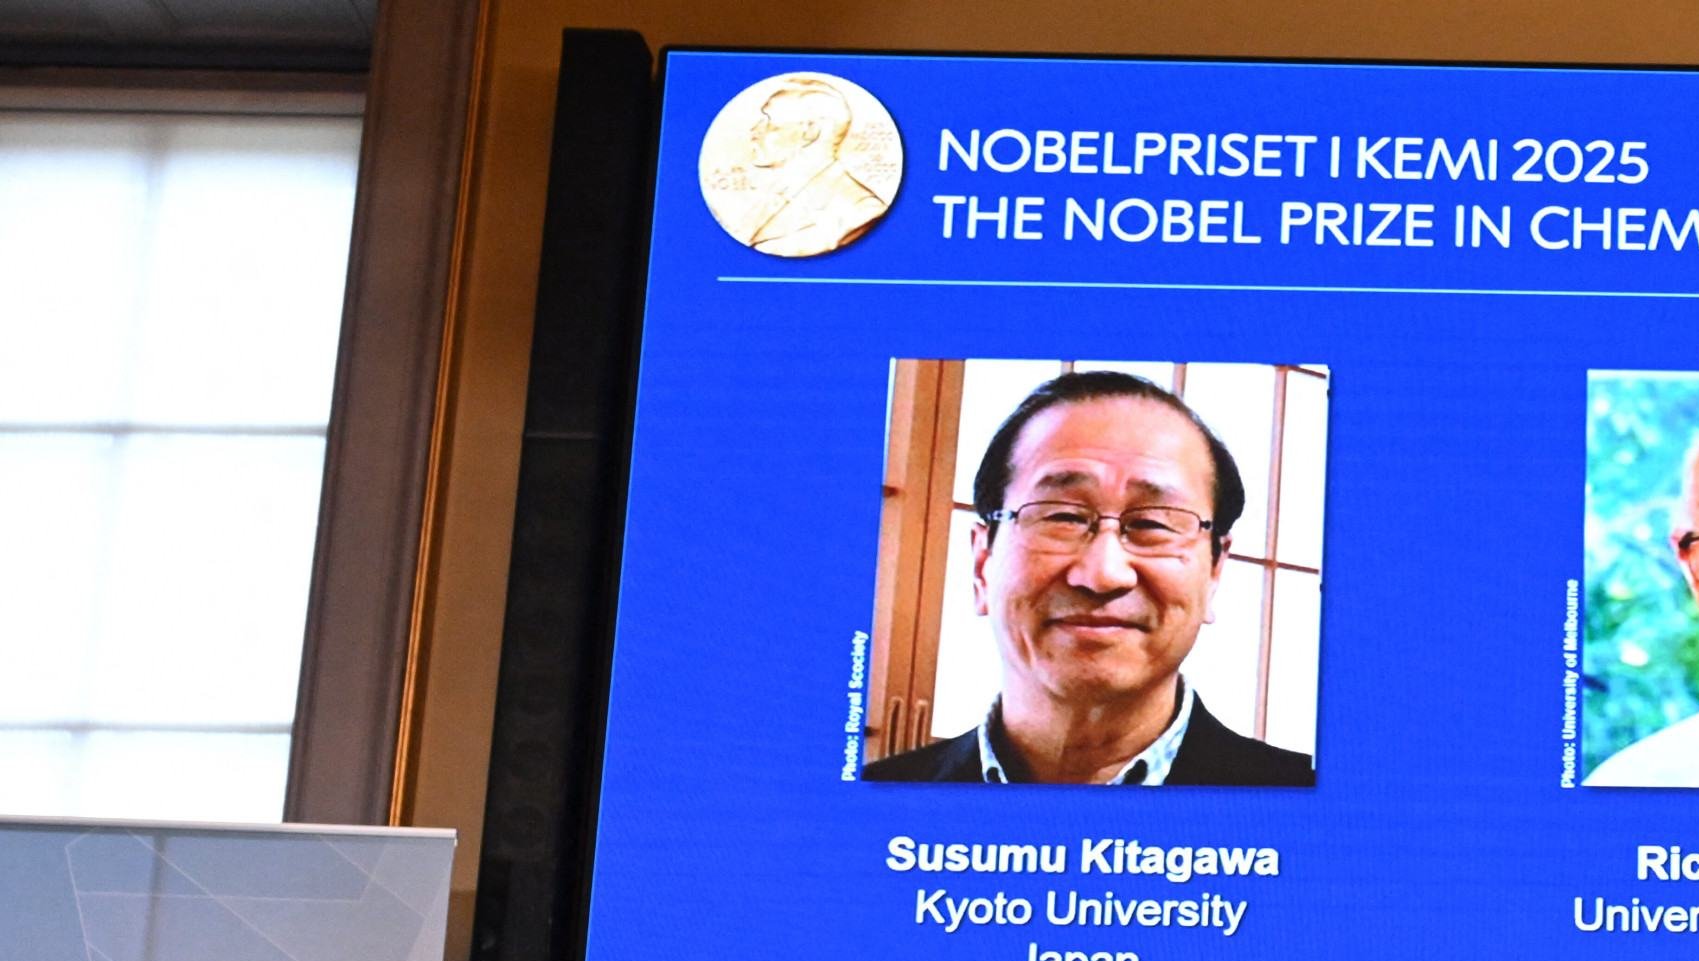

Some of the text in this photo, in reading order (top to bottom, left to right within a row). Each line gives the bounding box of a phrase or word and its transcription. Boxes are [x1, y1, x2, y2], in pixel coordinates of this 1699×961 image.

[939, 129, 1317, 177] NOBELPRISET
[1331, 136, 1340, 177] I
[1357, 137, 1497, 180] KEMI
[1512, 139, 1648, 184] 2025
[933, 195, 1044, 239] THE
[1065, 198, 1261, 243] NOBEL
[1281, 202, 1434, 246] PRIZE
[1456, 205, 1510, 248] IN
[1561, 579, 1580, 788] Photo: University of Melbourne
[845, 692, 863, 733] Royal
[841, 735, 859, 781] Photo:
[886, 836, 1278, 882] Susumu Kitagawa
[916, 889, 1247, 935] Kyoto University
